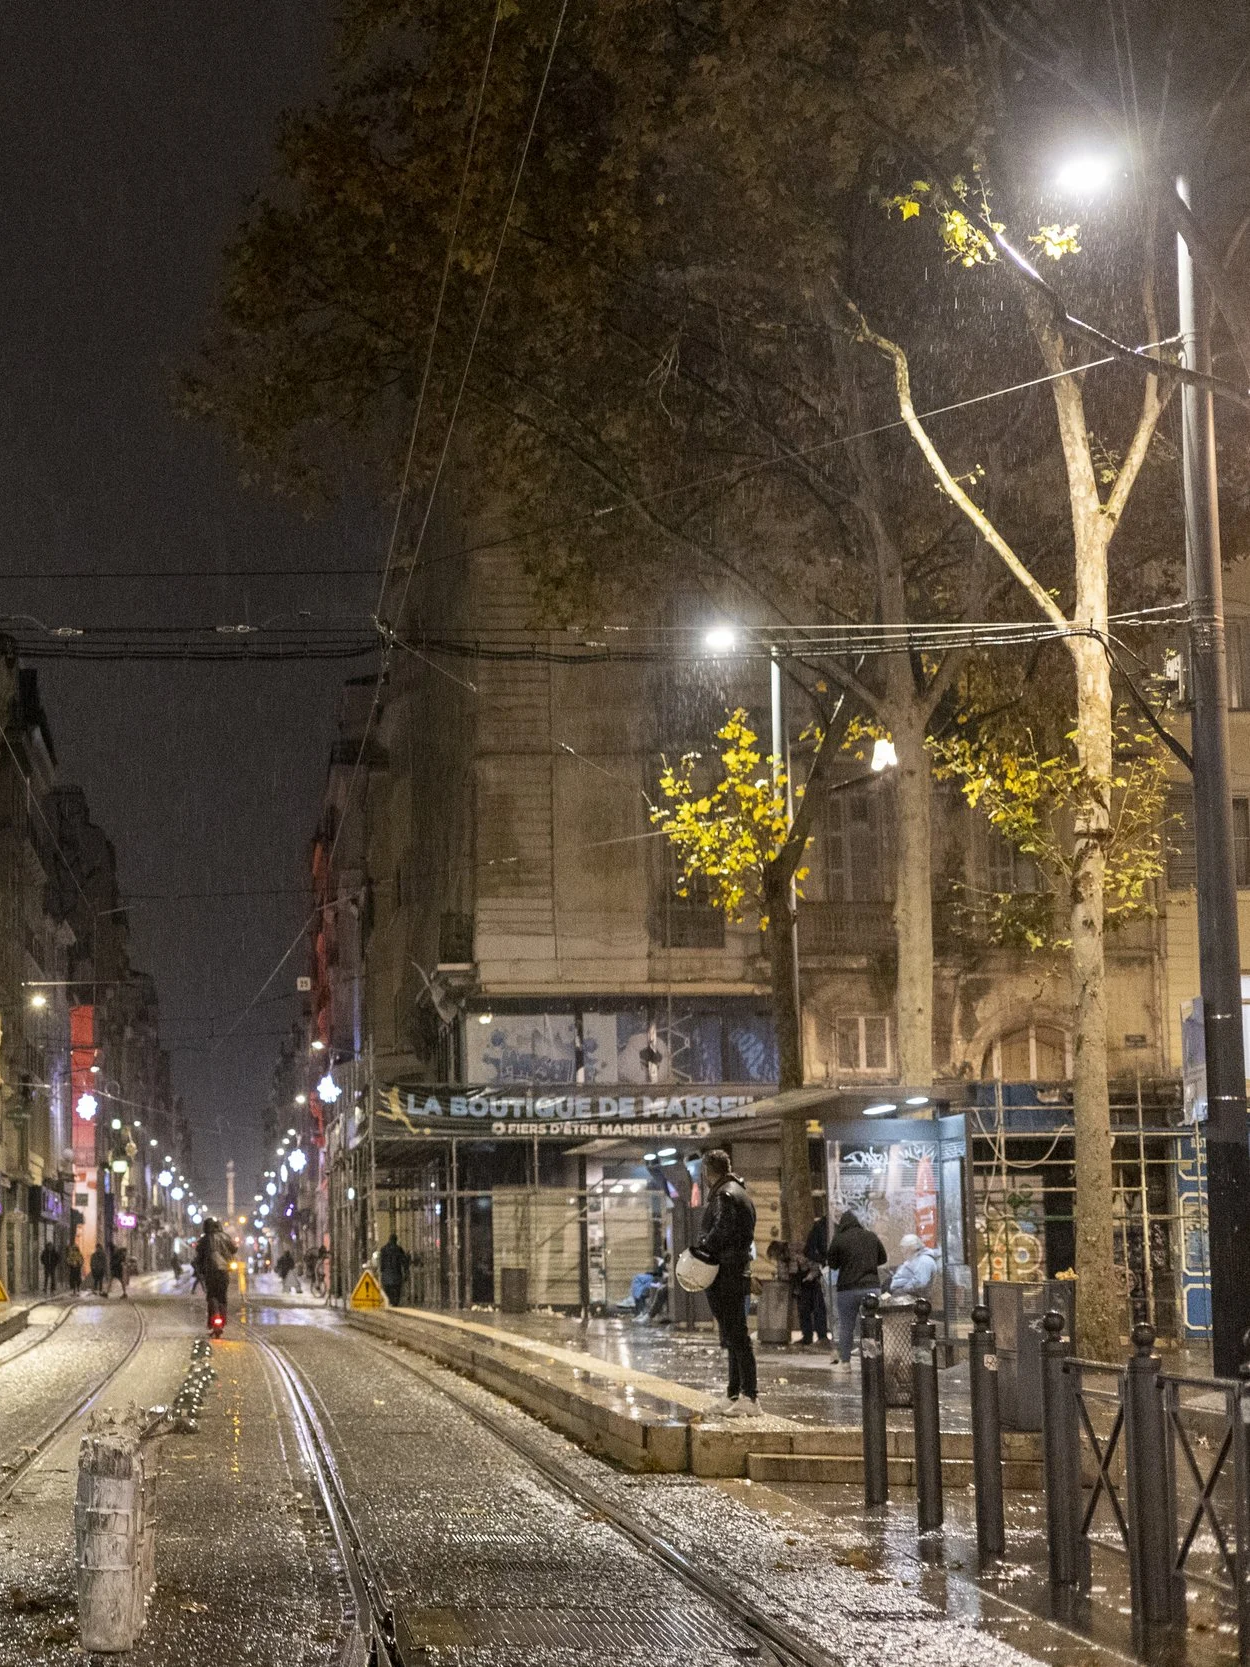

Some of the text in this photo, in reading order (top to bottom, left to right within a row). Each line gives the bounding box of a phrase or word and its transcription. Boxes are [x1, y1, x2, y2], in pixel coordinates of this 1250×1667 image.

[407, 1093, 442, 1116] LA
[450, 1096, 591, 1119] BOUTIQUE
[600, 1096, 636, 1118] DE
[508, 1124, 547, 1135] FIERS
[602, 1124, 692, 1136] MARSEILLAIS
